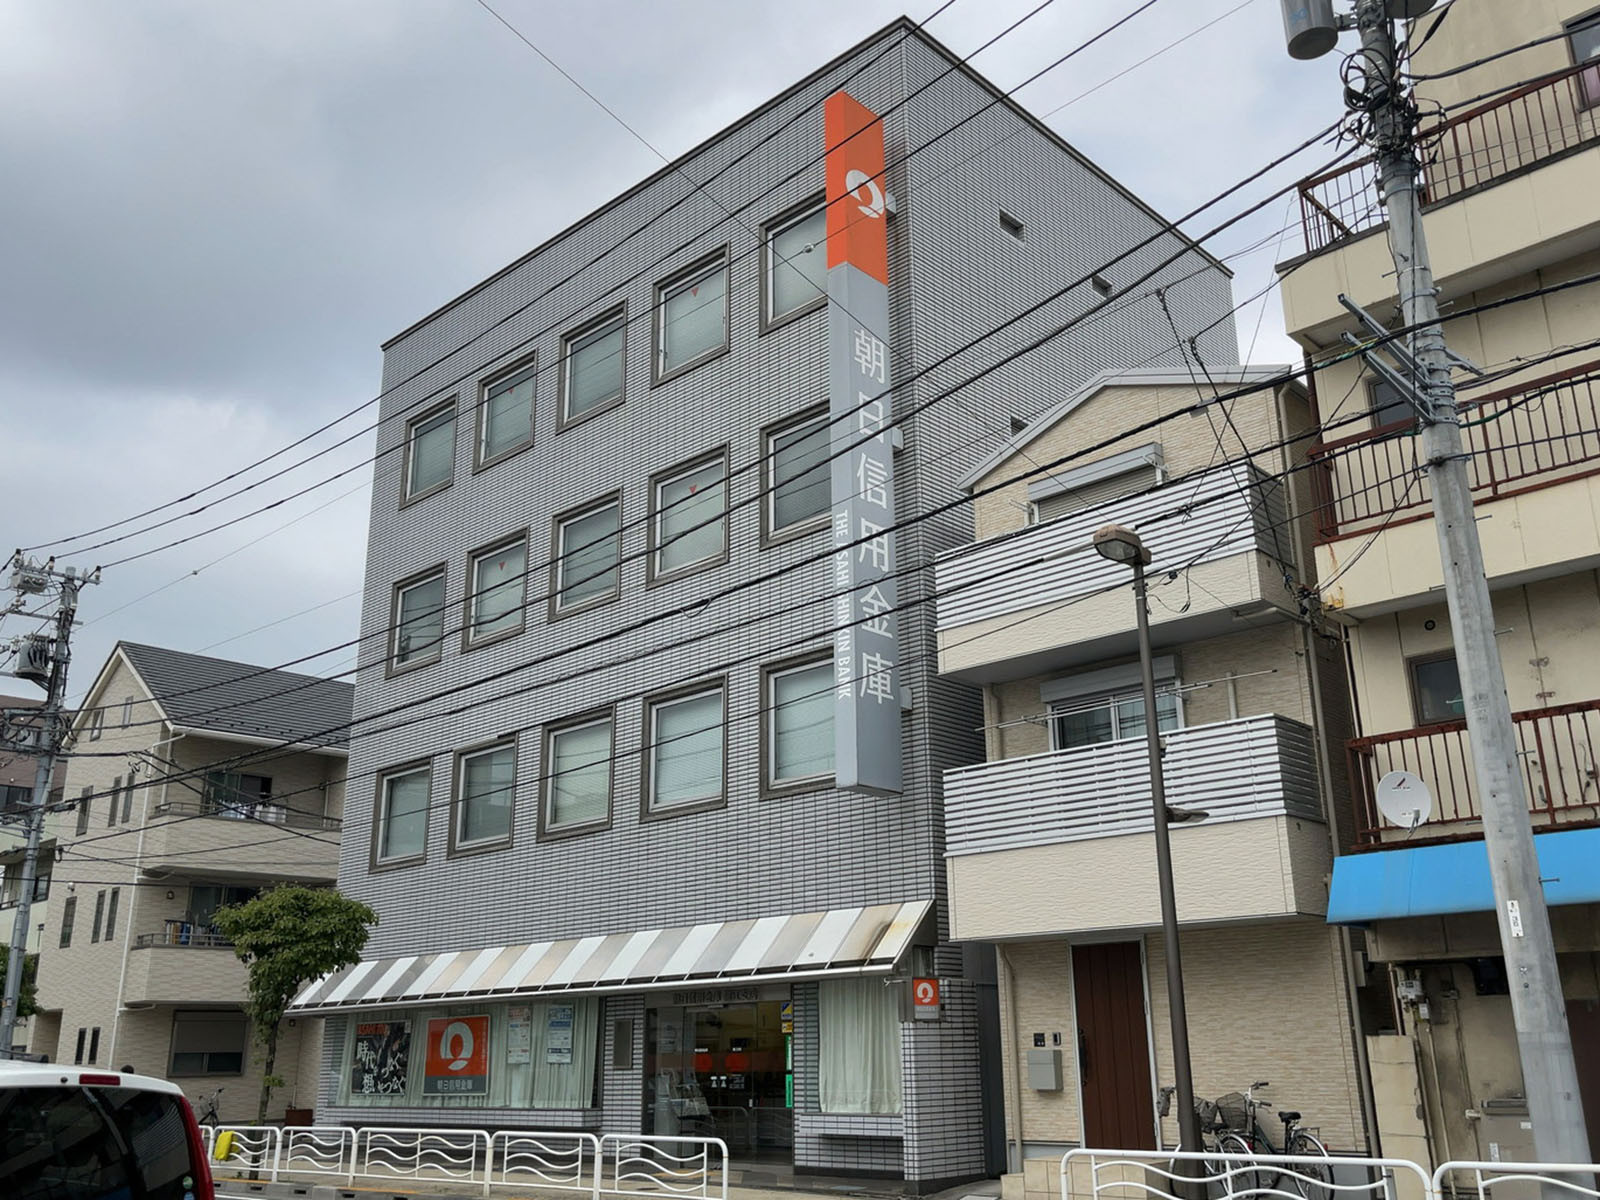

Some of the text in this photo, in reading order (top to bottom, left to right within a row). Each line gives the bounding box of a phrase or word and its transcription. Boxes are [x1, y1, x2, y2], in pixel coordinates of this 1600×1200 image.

[836, 509, 849, 538] THE
[854, 329, 894, 704] 朝日信用金庫
[838, 656, 851, 700] BANK
